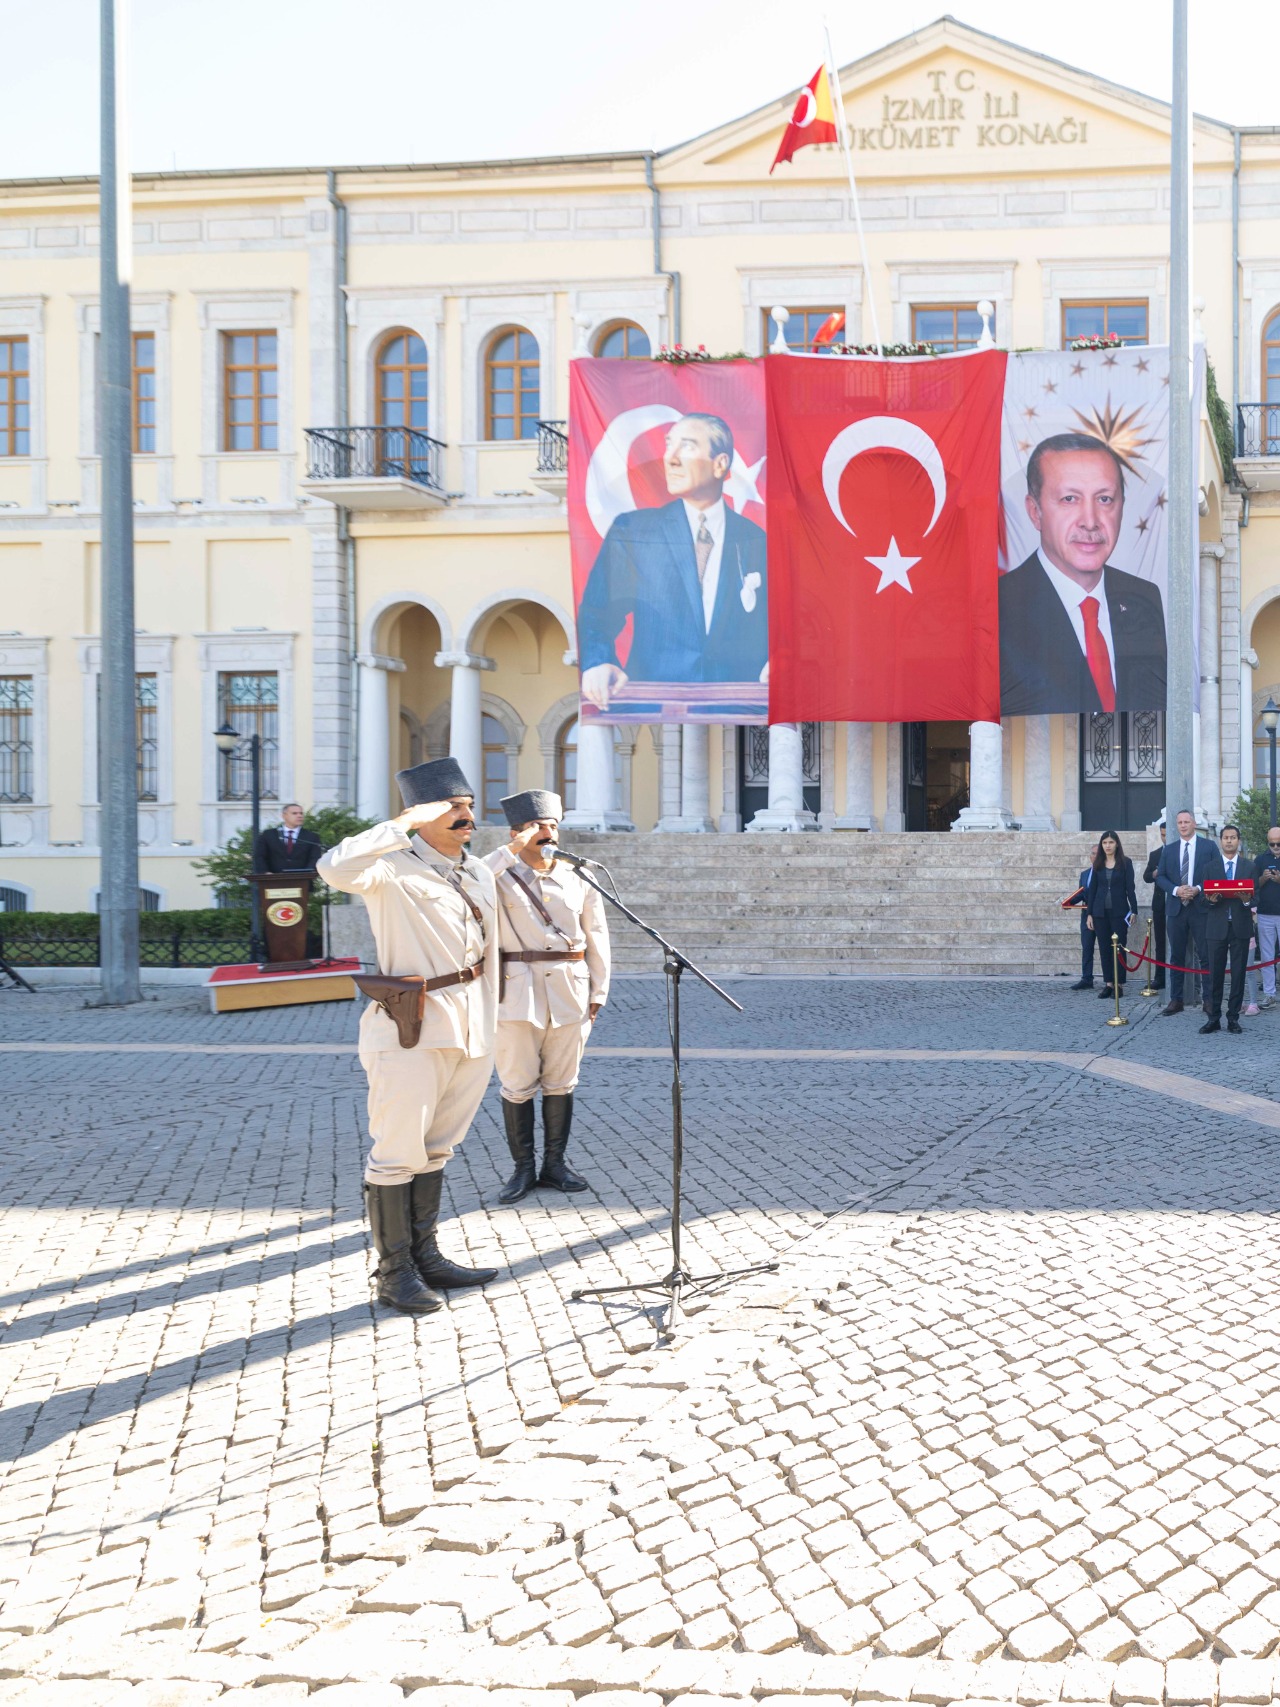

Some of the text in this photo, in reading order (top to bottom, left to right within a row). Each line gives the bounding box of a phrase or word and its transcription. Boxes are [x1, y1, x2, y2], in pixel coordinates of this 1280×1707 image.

[882, 91, 1019, 121] İZMİR İLİ
[814, 116, 1088, 151] ÜKÜMET KONAĞI
